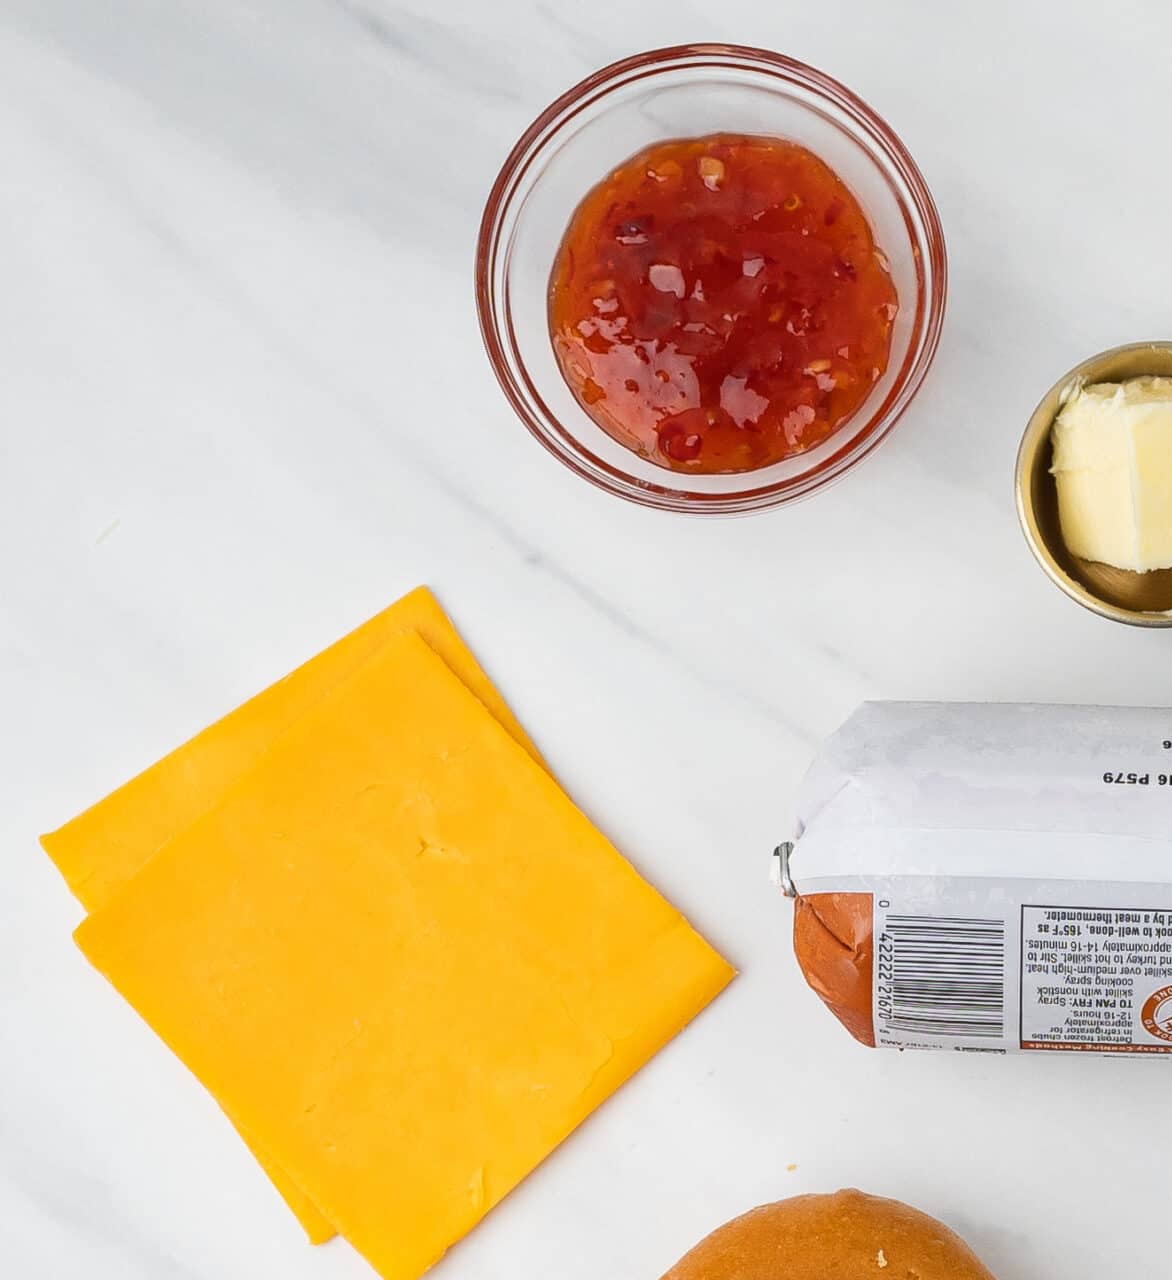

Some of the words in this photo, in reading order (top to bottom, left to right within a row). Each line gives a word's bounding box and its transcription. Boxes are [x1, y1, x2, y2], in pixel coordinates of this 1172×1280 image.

[1103, 773, 1149, 785] P579
[879, 900, 889, 908] 0
[1044, 911, 1112, 924] thermometer.
[1115, 914, 1140, 924] meat
[1144, 914, 1150, 923] a
[1153, 912, 1165, 925] by
[1038, 924, 1049, 933] as
[1052, 925, 1081, 936] 165°F
[1086, 924, 1140, 937] well-done,
[1142, 928, 1153, 937] to
[1025, 940, 1068, 951] minutes.
[1070, 941, 1098, 952] 14-16
[1102, 940, 1172, 953] approximately
[878, 933, 892, 980] 42222
[1028, 952, 1037, 961] to
[1039, 952, 1058, 963] Stir
[1061, 953, 1092, 964] skillet.
[1095, 954, 1111, 964] hot
[1114, 955, 1123, 964] to
[1126, 953, 1157, 966] turkey
[1025, 964, 1048, 975] heat.
[1051, 964, 1117, 976] medium-high
[1120, 966, 1141, 975] over
[1144, 968, 1172, 978] skillet
[1063, 975, 1092, 984] spray.
[1095, 976, 1133, 986] cooking
[1037, 987, 1078, 996] nonstick
[1081, 988, 1102, 997] with
[1105, 988, 1133, 997] skillet
[878, 986, 892, 1020] 21670
[1037, 996, 1066, 1006] Spray
[1069, 998, 1092, 1007] FRY:
[1095, 999, 1116, 1008] PAN
[1119, 999, 1133, 1008] TO
[1070, 1010, 1101, 1019] hours.
[1104, 1011, 1131, 1019] 12-16
[1064, 1017, 1133, 1027] approximately
[1144, 1018, 1155, 1031] TO
[1066, 1026, 1122, 1035] refrigerator
